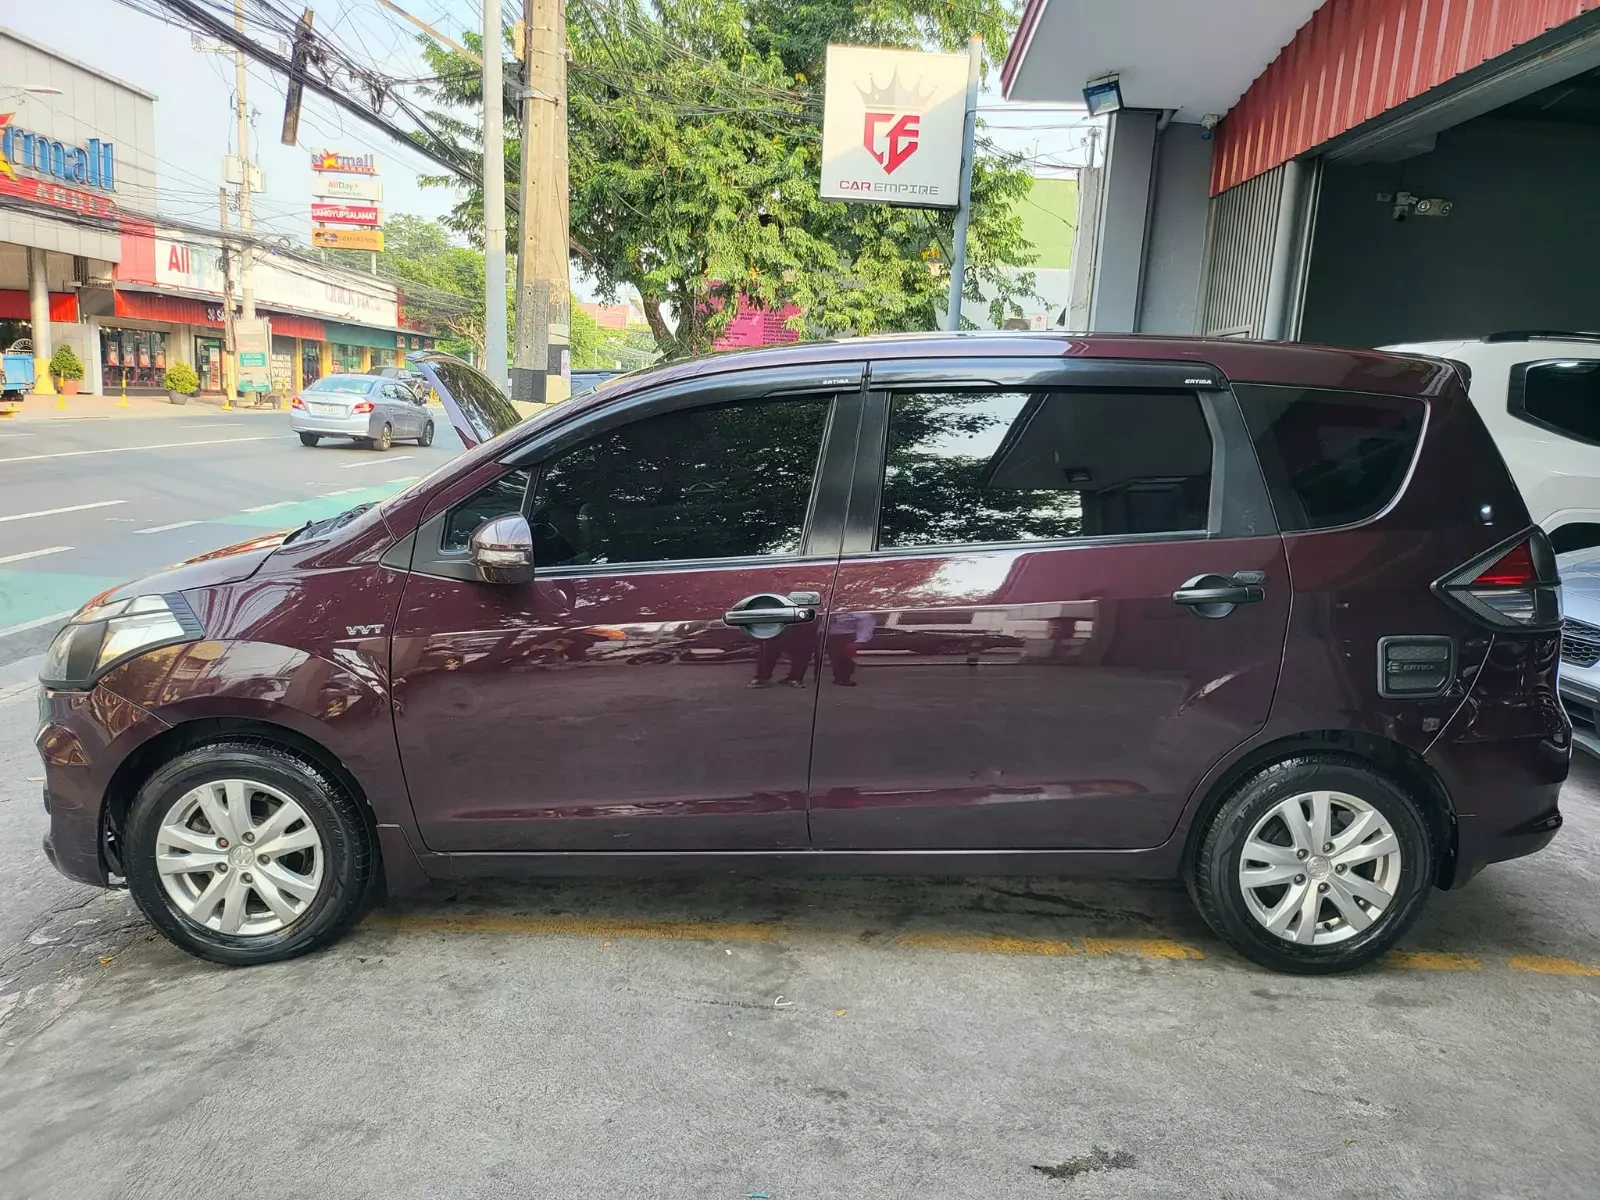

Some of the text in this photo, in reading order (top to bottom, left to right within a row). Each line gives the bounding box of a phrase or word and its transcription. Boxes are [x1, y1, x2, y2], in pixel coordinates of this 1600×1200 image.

[840, 180, 939, 195] CAR EMPIRE
[312, 209, 376, 221] SAMGYUPSALAMAT
[345, 624, 385, 635] VVT
